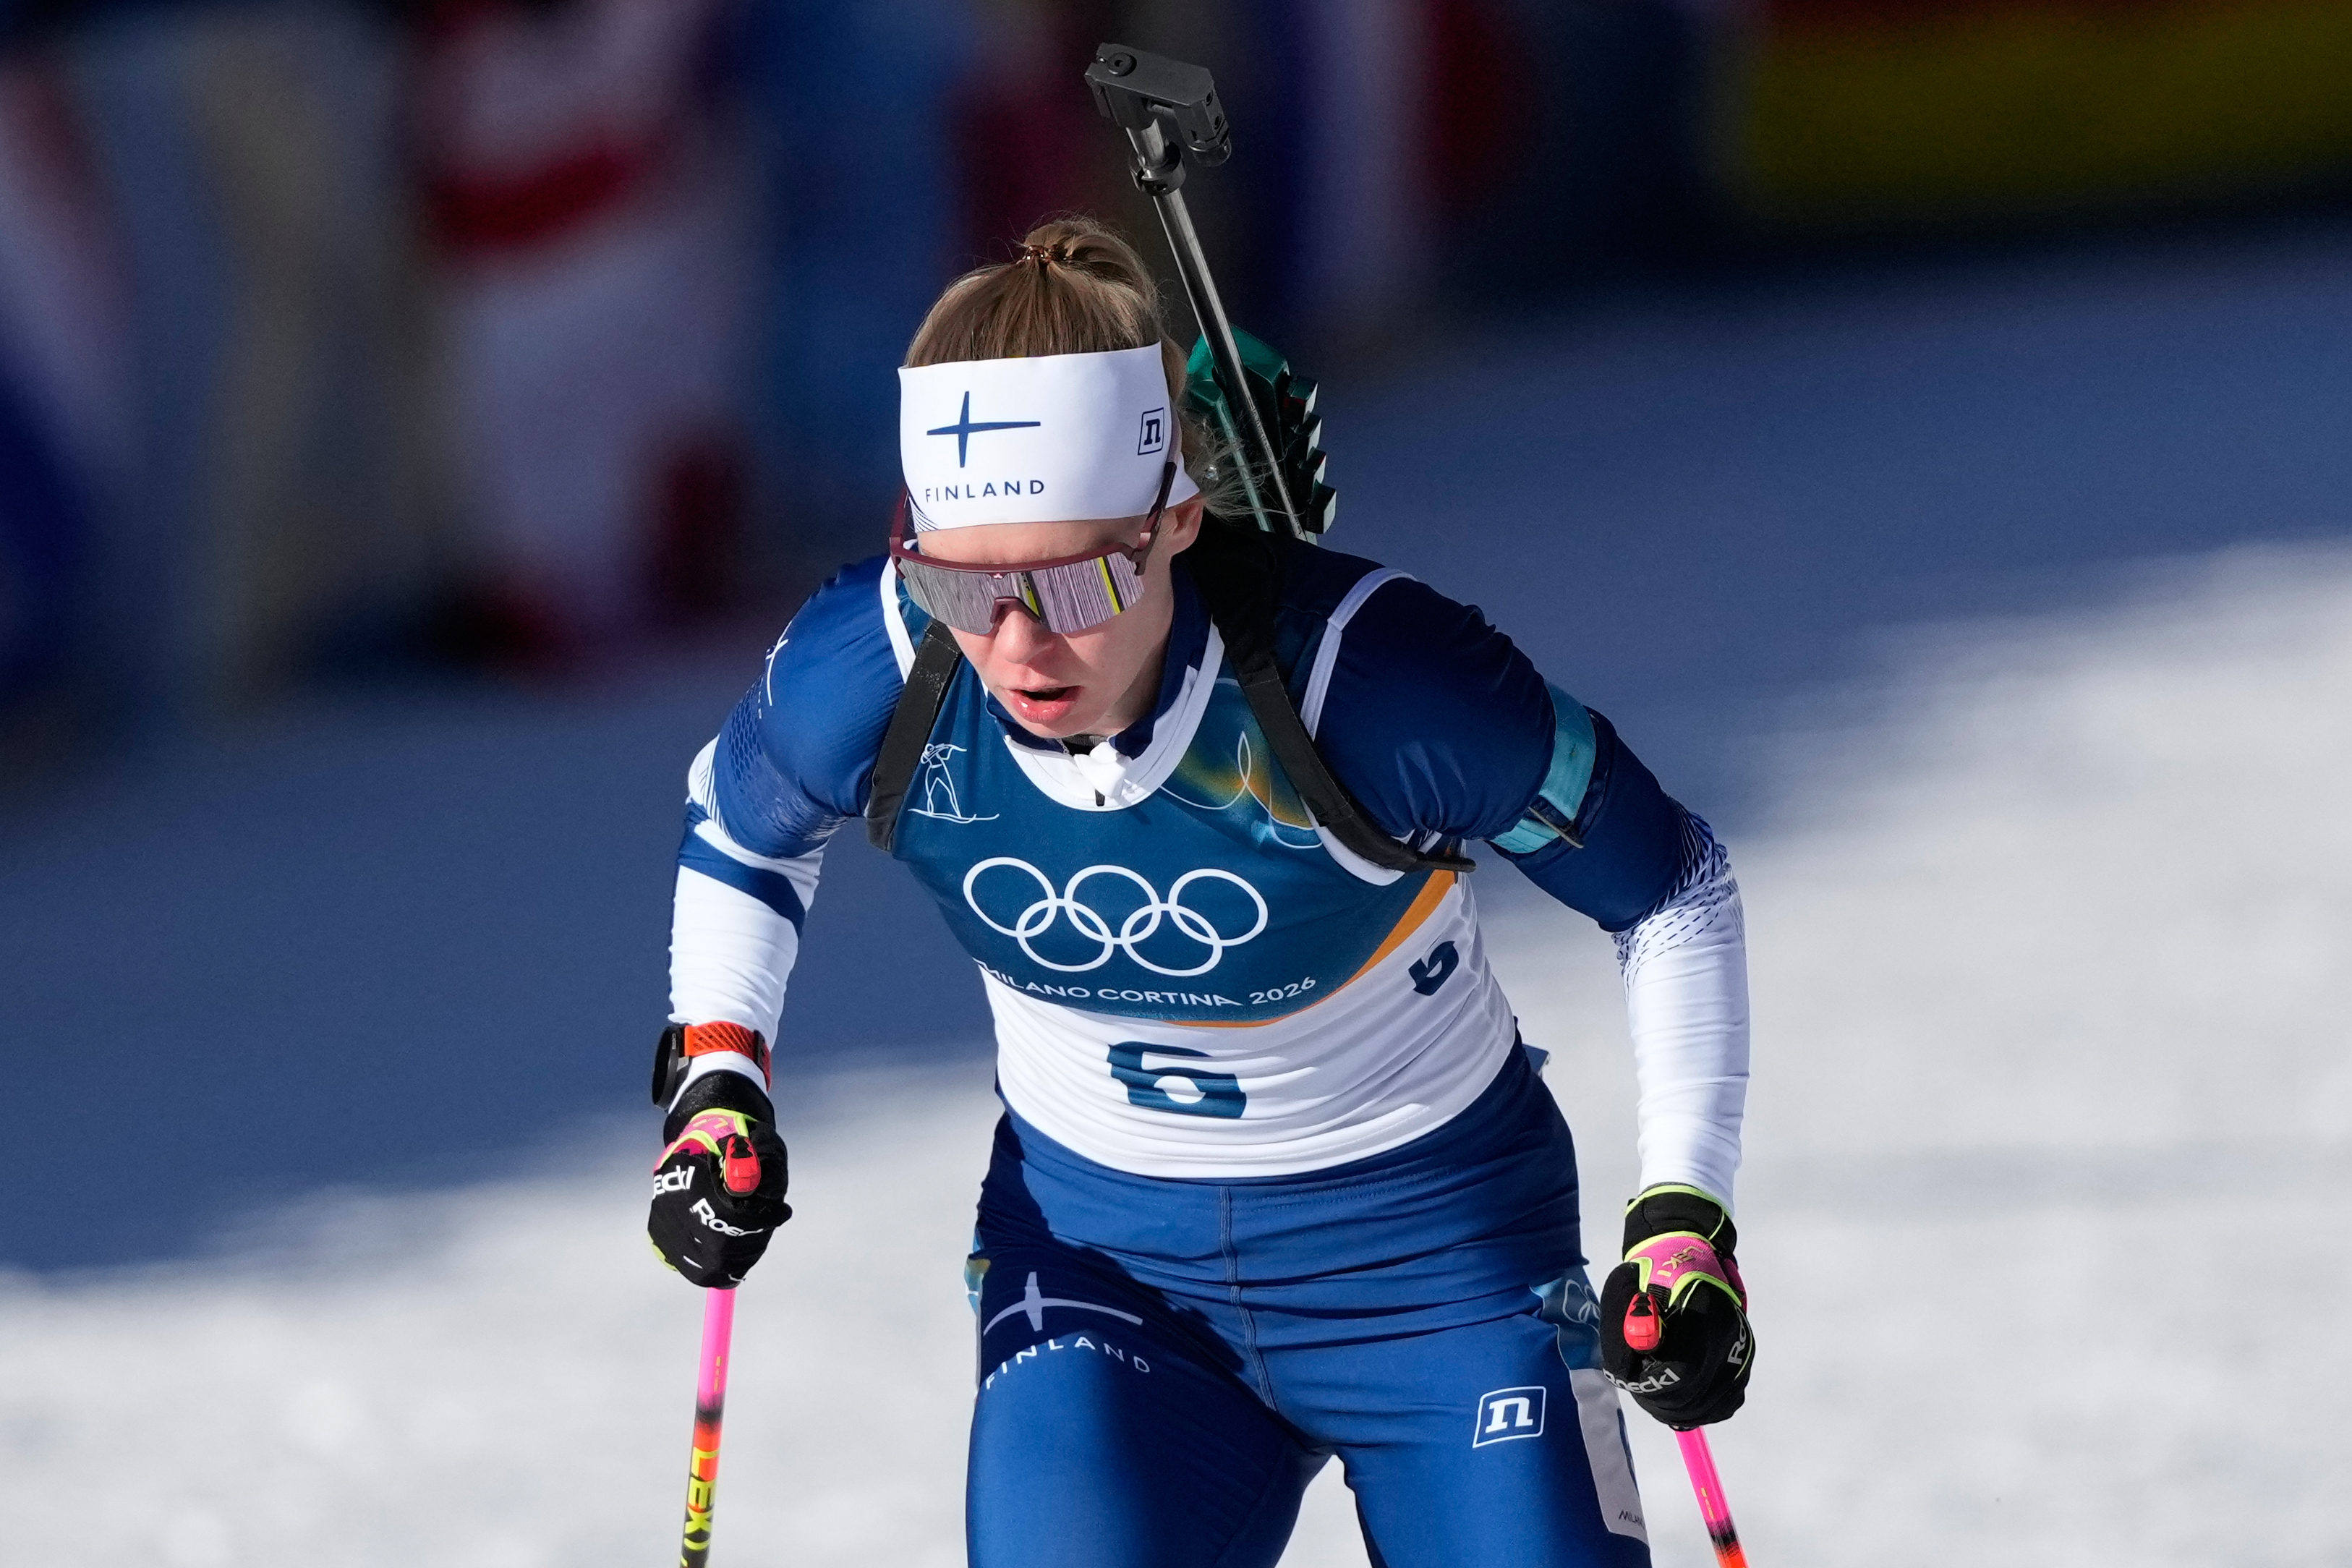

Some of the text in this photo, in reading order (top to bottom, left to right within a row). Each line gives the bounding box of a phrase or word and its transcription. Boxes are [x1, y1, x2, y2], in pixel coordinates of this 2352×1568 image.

[925, 480, 1044, 503] FINLAND
[972, 958, 1316, 1007] MILANO CORTINA 2026
[1107, 1040, 1247, 1118] 6
[986, 1337, 1150, 1389] FINLAND
